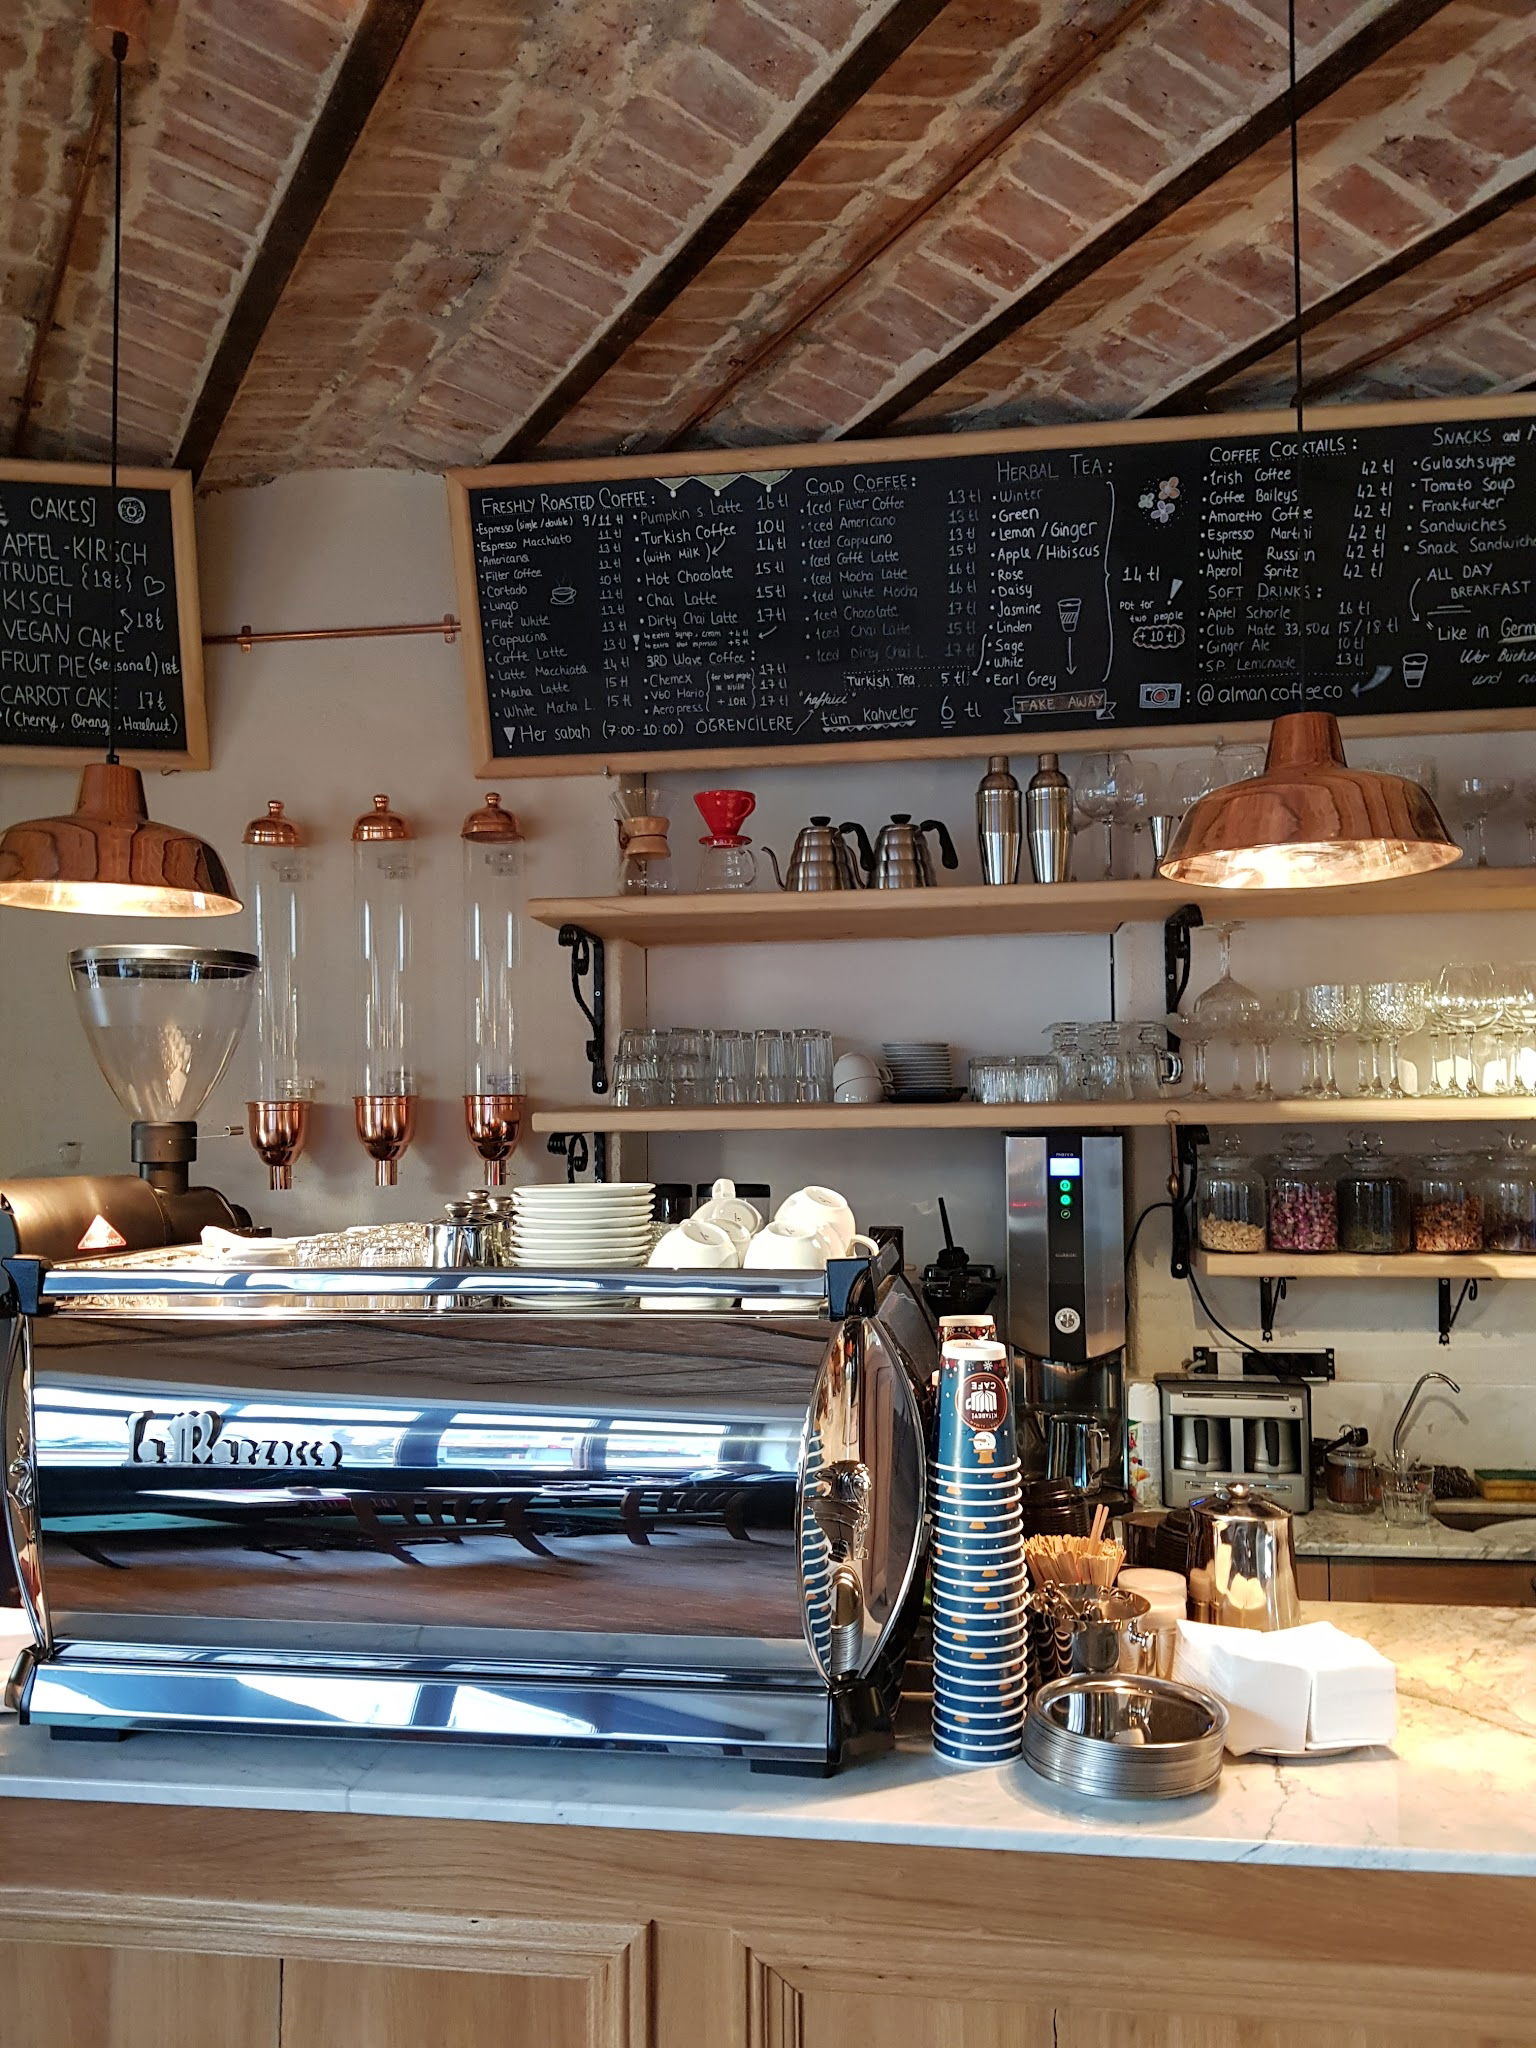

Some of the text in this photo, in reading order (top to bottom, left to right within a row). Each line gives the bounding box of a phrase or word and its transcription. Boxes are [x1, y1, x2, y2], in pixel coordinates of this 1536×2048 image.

[1432, 427, 1491, 446] SNACKS
[1503, 429, 1520, 442] and
[1210, 447, 1261, 462] COFFEE
[998, 461, 1059, 482] HERBAL
[1421, 455, 1516, 475] Gulaschsuppe
[1211, 468, 1291, 485] Irish Coffee
[806, 478, 844, 495] COLD
[1421, 477, 1515, 495] Tomato Soup
[1000, 488, 1043, 502] Winter
[1210, 488, 1297, 505] Coffee Baileys
[482, 493, 595, 515] FRESHLY ROASTED
[641, 499, 743, 525] Pumpkin Latte
[807, 501, 831, 515] Iced
[872, 495, 904, 511] Coffee
[1423, 497, 1504, 512] Frankfurter
[840, 516, 896, 530] Americano
[999, 508, 1039, 522] Green
[1209, 511, 1262, 523] Amaretto
[478, 523, 513, 539] Espresso
[1420, 518, 1507, 533] Sandwiches
[641, 523, 736, 545] Turkish Coffee
[1208, 529, 1254, 544] Espresso
[481, 534, 572, 556] Espresso Macchiato
[809, 536, 830, 549] Iced
[1417, 540, 1459, 554] Snack
[810, 551, 899, 567] Iced Latte
[1208, 548, 1243, 560] White
[486, 571, 509, 582] Filter
[646, 566, 733, 585] Hot Chocolate
[811, 568, 908, 585] Iced Mocha Latte
[998, 569, 1023, 581] Rose
[1207, 563, 1298, 580] Aperol Spritz
[1427, 563, 1493, 581] ALL DAY
[487, 584, 527, 597] Cortado
[812, 589, 834, 602] Iced
[998, 584, 1033, 599] Daisy
[1208, 585, 1244, 600] SOFT
[1451, 581, 1531, 599] BREAKFAST
[3, 588, 71, 618] KISCH
[647, 592, 717, 606] Chai Latte
[489, 602, 518, 618] Lungo
[843, 604, 899, 620] Chocolate
[997, 600, 1041, 617] Jasmine
[1208, 605, 1290, 621] Apfel Schorle
[491, 616, 550, 629] Flat White
[648, 612, 738, 629] Dirty Chai Latte
[1154, 611, 1183, 624] people
[3, 619, 70, 645] VEGAN
[996, 621, 1032, 633] Linden
[1207, 625, 1276, 636] Club Mate
[1477, 624, 1489, 638] in
[537, 648, 567, 659] Latte
[995, 639, 1024, 656] Sage
[1207, 640, 1270, 657] Ginger Ale
[1, 651, 87, 678] FRUIT PIE
[673, 654, 702, 665] Wave
[994, 657, 1023, 668] White
[498, 669, 527, 681] Latte
[847, 674, 915, 687] Turkish Tea
[994, 671, 1056, 690] Earl Grey
[0, 685, 70, 706] CARROT
[541, 684, 570, 694] Latte
[677, 689, 704, 699] Hario
[504, 703, 537, 718] White
[941, 696, 954, 720] 6
[1016, 694, 1104, 712] TAKE AWAY
[520, 725, 547, 743] Her
[554, 724, 590, 741] sabah
